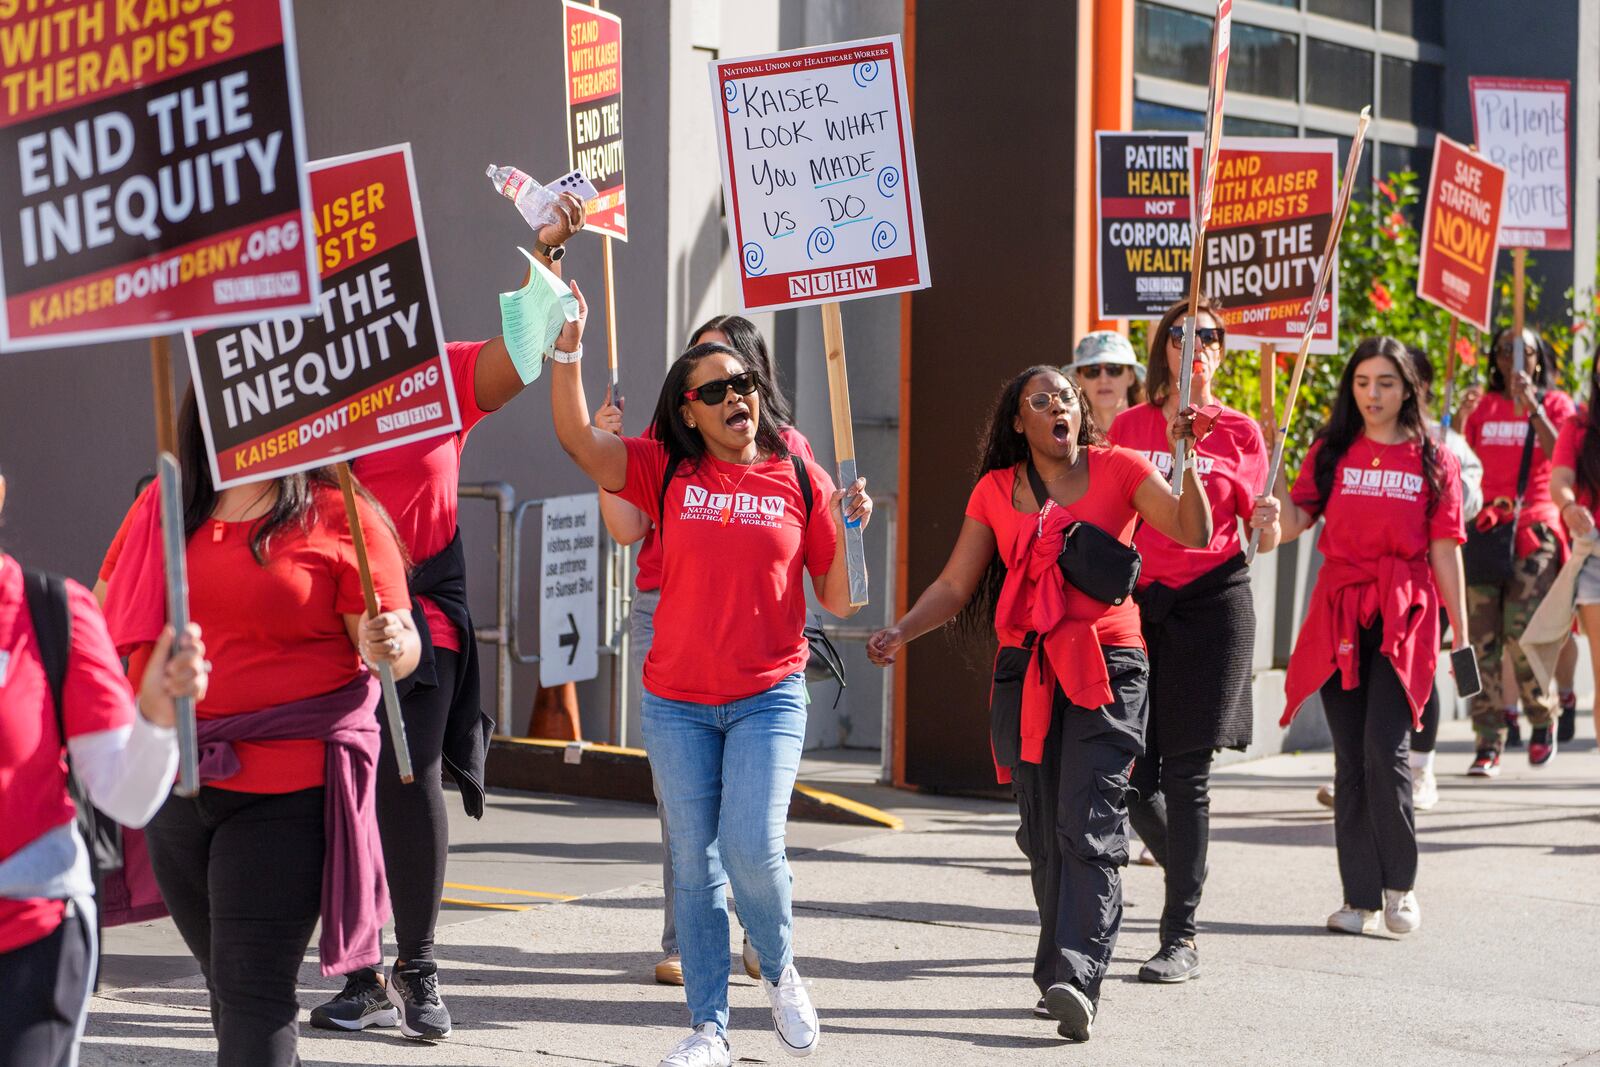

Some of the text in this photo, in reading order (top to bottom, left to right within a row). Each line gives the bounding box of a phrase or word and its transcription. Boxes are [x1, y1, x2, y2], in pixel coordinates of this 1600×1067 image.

[1, 9, 104, 68] WITH
[571, 21, 598, 46] STAND
[2, 10, 235, 116] THERAPISTS
[572, 47, 594, 72] WITH
[723, 48, 889, 77] NATIONAL UNION OF HEALTHCARE WORKERS
[573, 68, 617, 98] THERAPISTS
[743, 83, 838, 118] KAISER
[1481, 93, 1567, 136] Patients
[18, 71, 252, 196] END THE
[576, 103, 619, 144] END THE
[745, 110, 888, 150] LOOK WHAT
[810, 151, 875, 184] MADE
[1127, 171, 1190, 195] HEALTH
[1215, 156, 1261, 180] TAND
[1454, 160, 1483, 194] SAFE
[19, 131, 283, 266] INEQUITY
[1212, 169, 1318, 204] ITH KAISER
[1440, 180, 1492, 226] STAFFING
[1507, 183, 1568, 220] ROFITS
[313, 182, 385, 237] ISER
[821, 195, 866, 221] DO
[1145, 201, 1176, 215] NOT
[1212, 193, 1309, 226] HERAPISTS
[1109, 222, 1192, 247] CORPORA
[1207, 223, 1313, 266] END THE
[1434, 205, 1490, 265] NOW
[29, 220, 300, 328] KAISERDONTDENY.ORG
[1125, 249, 1192, 272] WEALTH
[1206, 254, 1325, 299] INEQUITY
[789, 267, 876, 297] NUHW
[216, 263, 396, 379] END THE
[222, 302, 420, 428] INEQUITY
[235, 365, 439, 470] KAISERDONTDENY.ORG
[377, 402, 443, 433] NUHW
[1343, 467, 1423, 493] NUHW
[685, 486, 784, 516] NUHW
[687, 507, 722, 516] NATION
[547, 509, 586, 531] Patients and
[680, 513, 782, 528] HEALTHCAE WORKERS
[573, 534, 594, 554] please
[546, 558, 587, 577] use entrance
[545, 576, 594, 599] on Sunset Blvd
